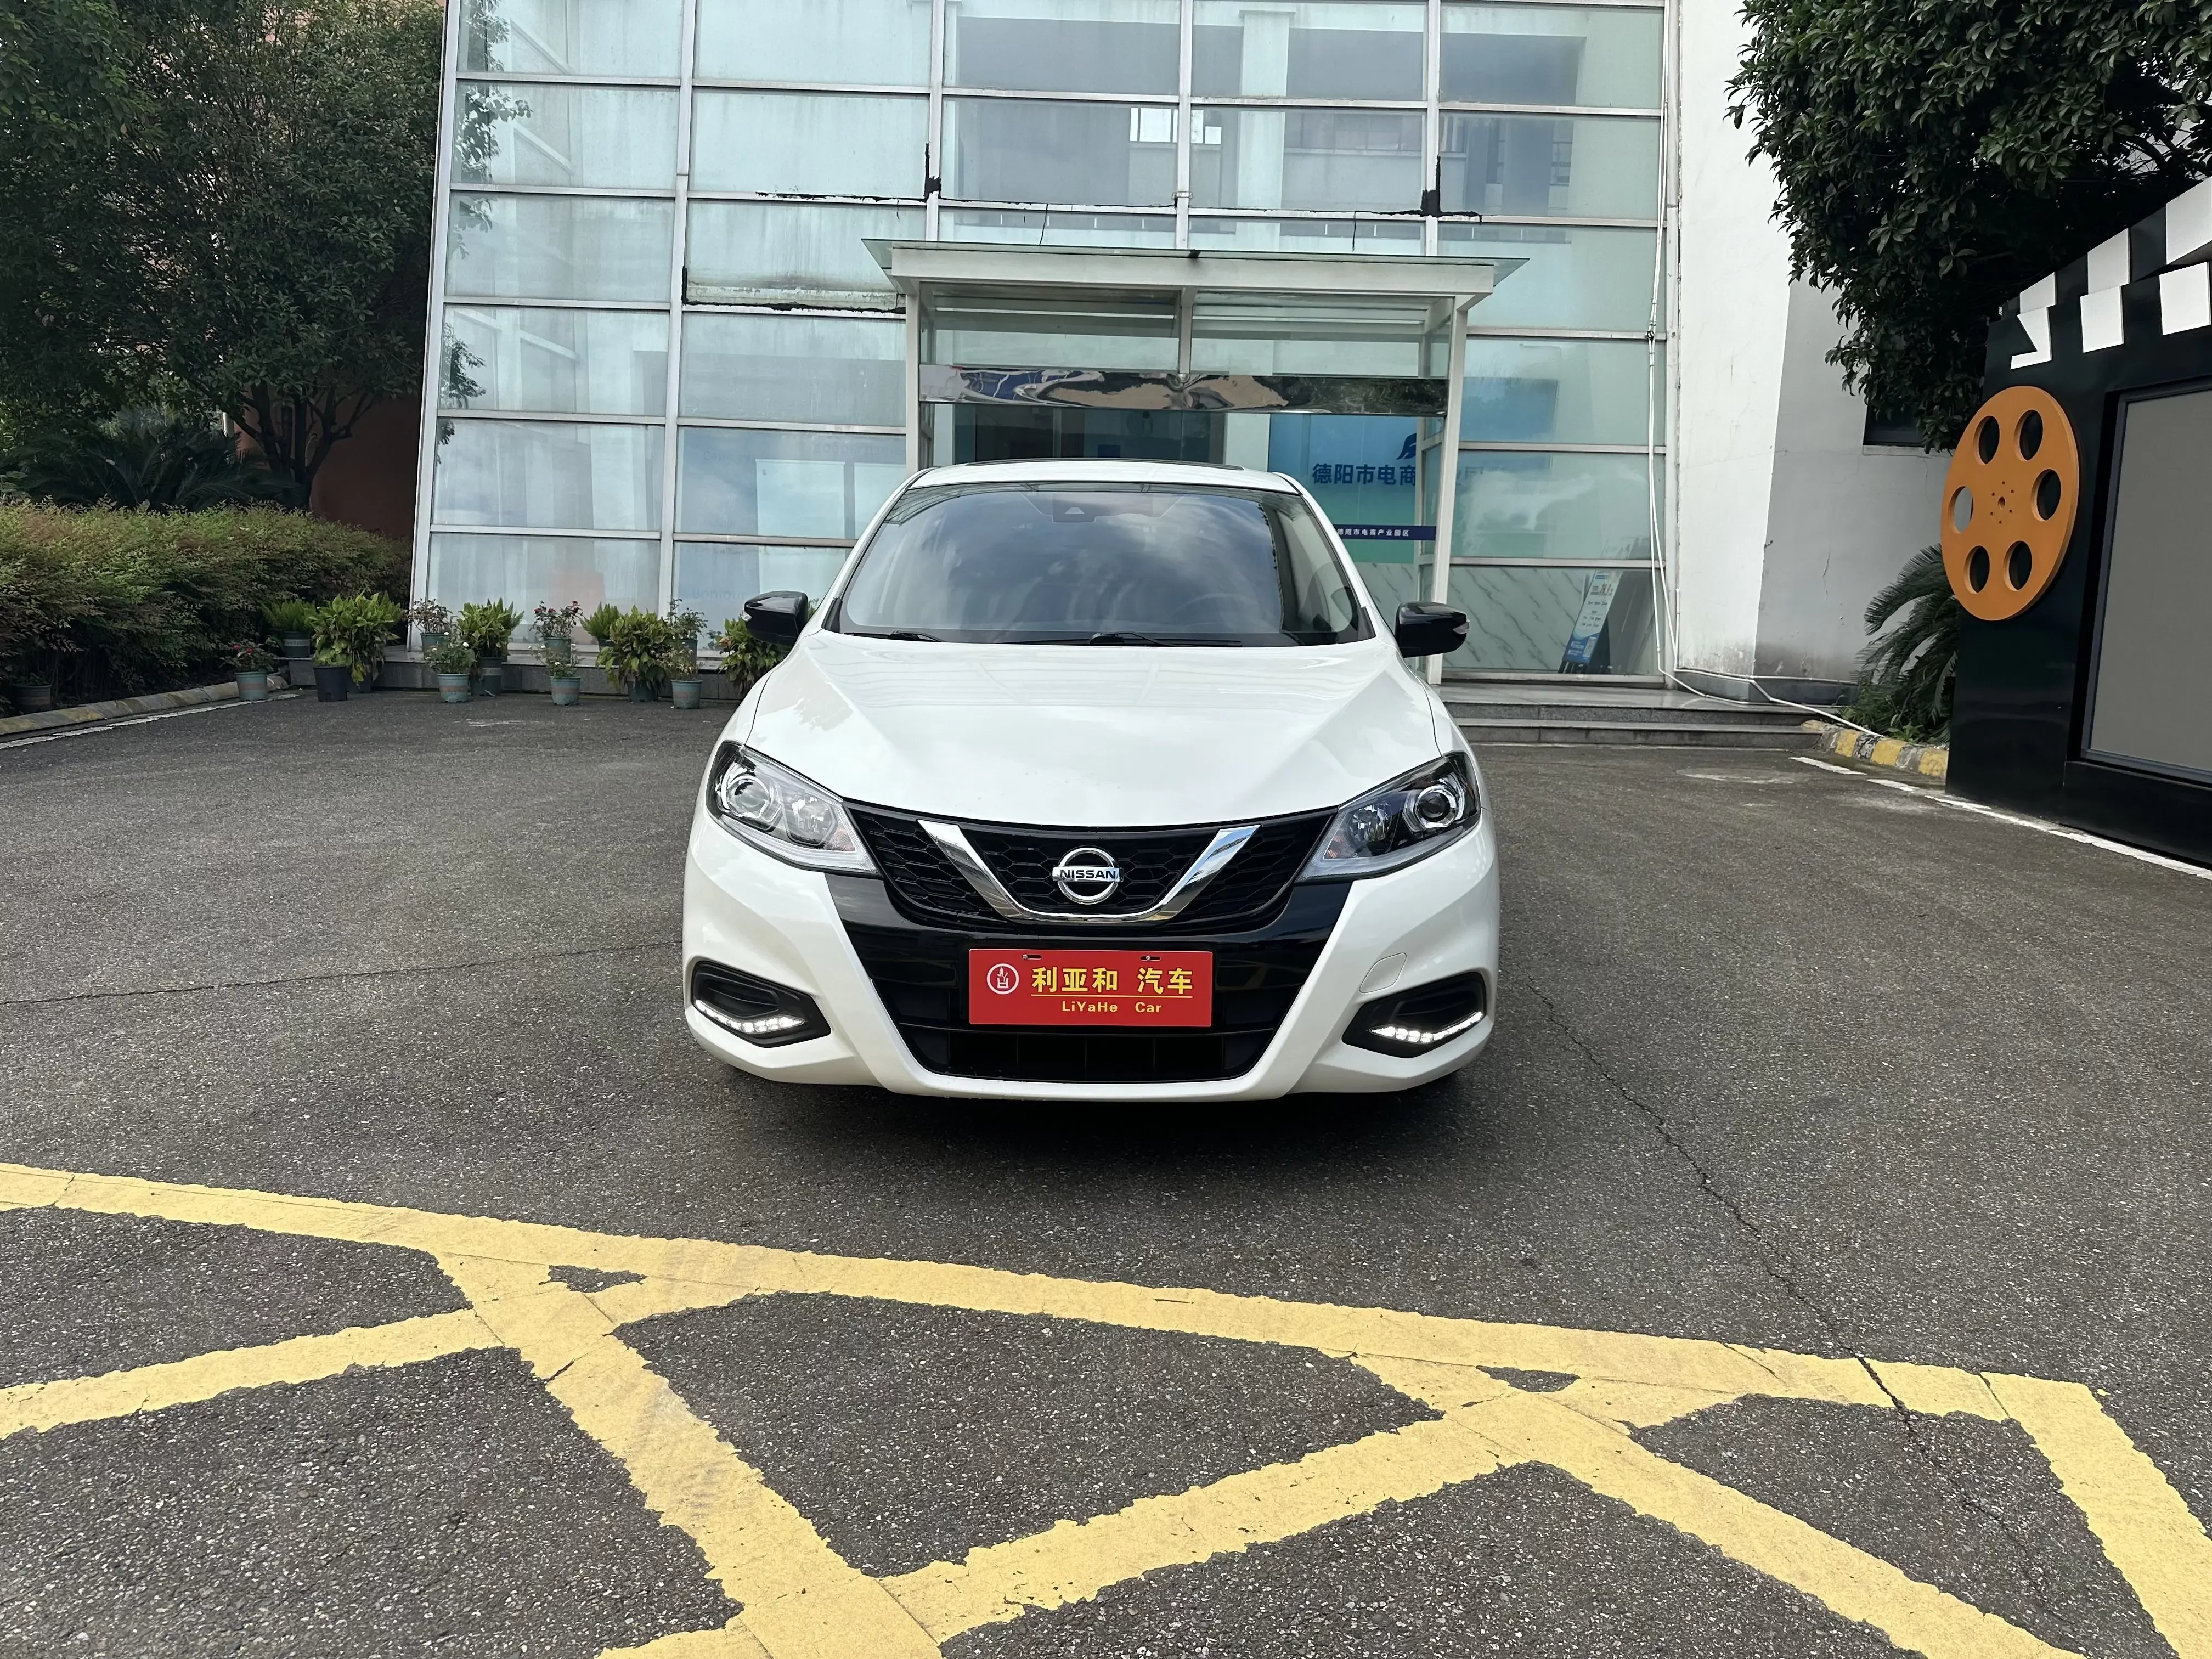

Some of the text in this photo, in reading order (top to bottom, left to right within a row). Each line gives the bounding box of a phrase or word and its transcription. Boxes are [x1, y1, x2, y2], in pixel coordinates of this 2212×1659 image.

[1060, 870, 1116, 879] NISSAN
[1031, 967, 1193, 994] 利亚和 汽车
[1062, 1001, 1162, 1013] LiYaHe Car
